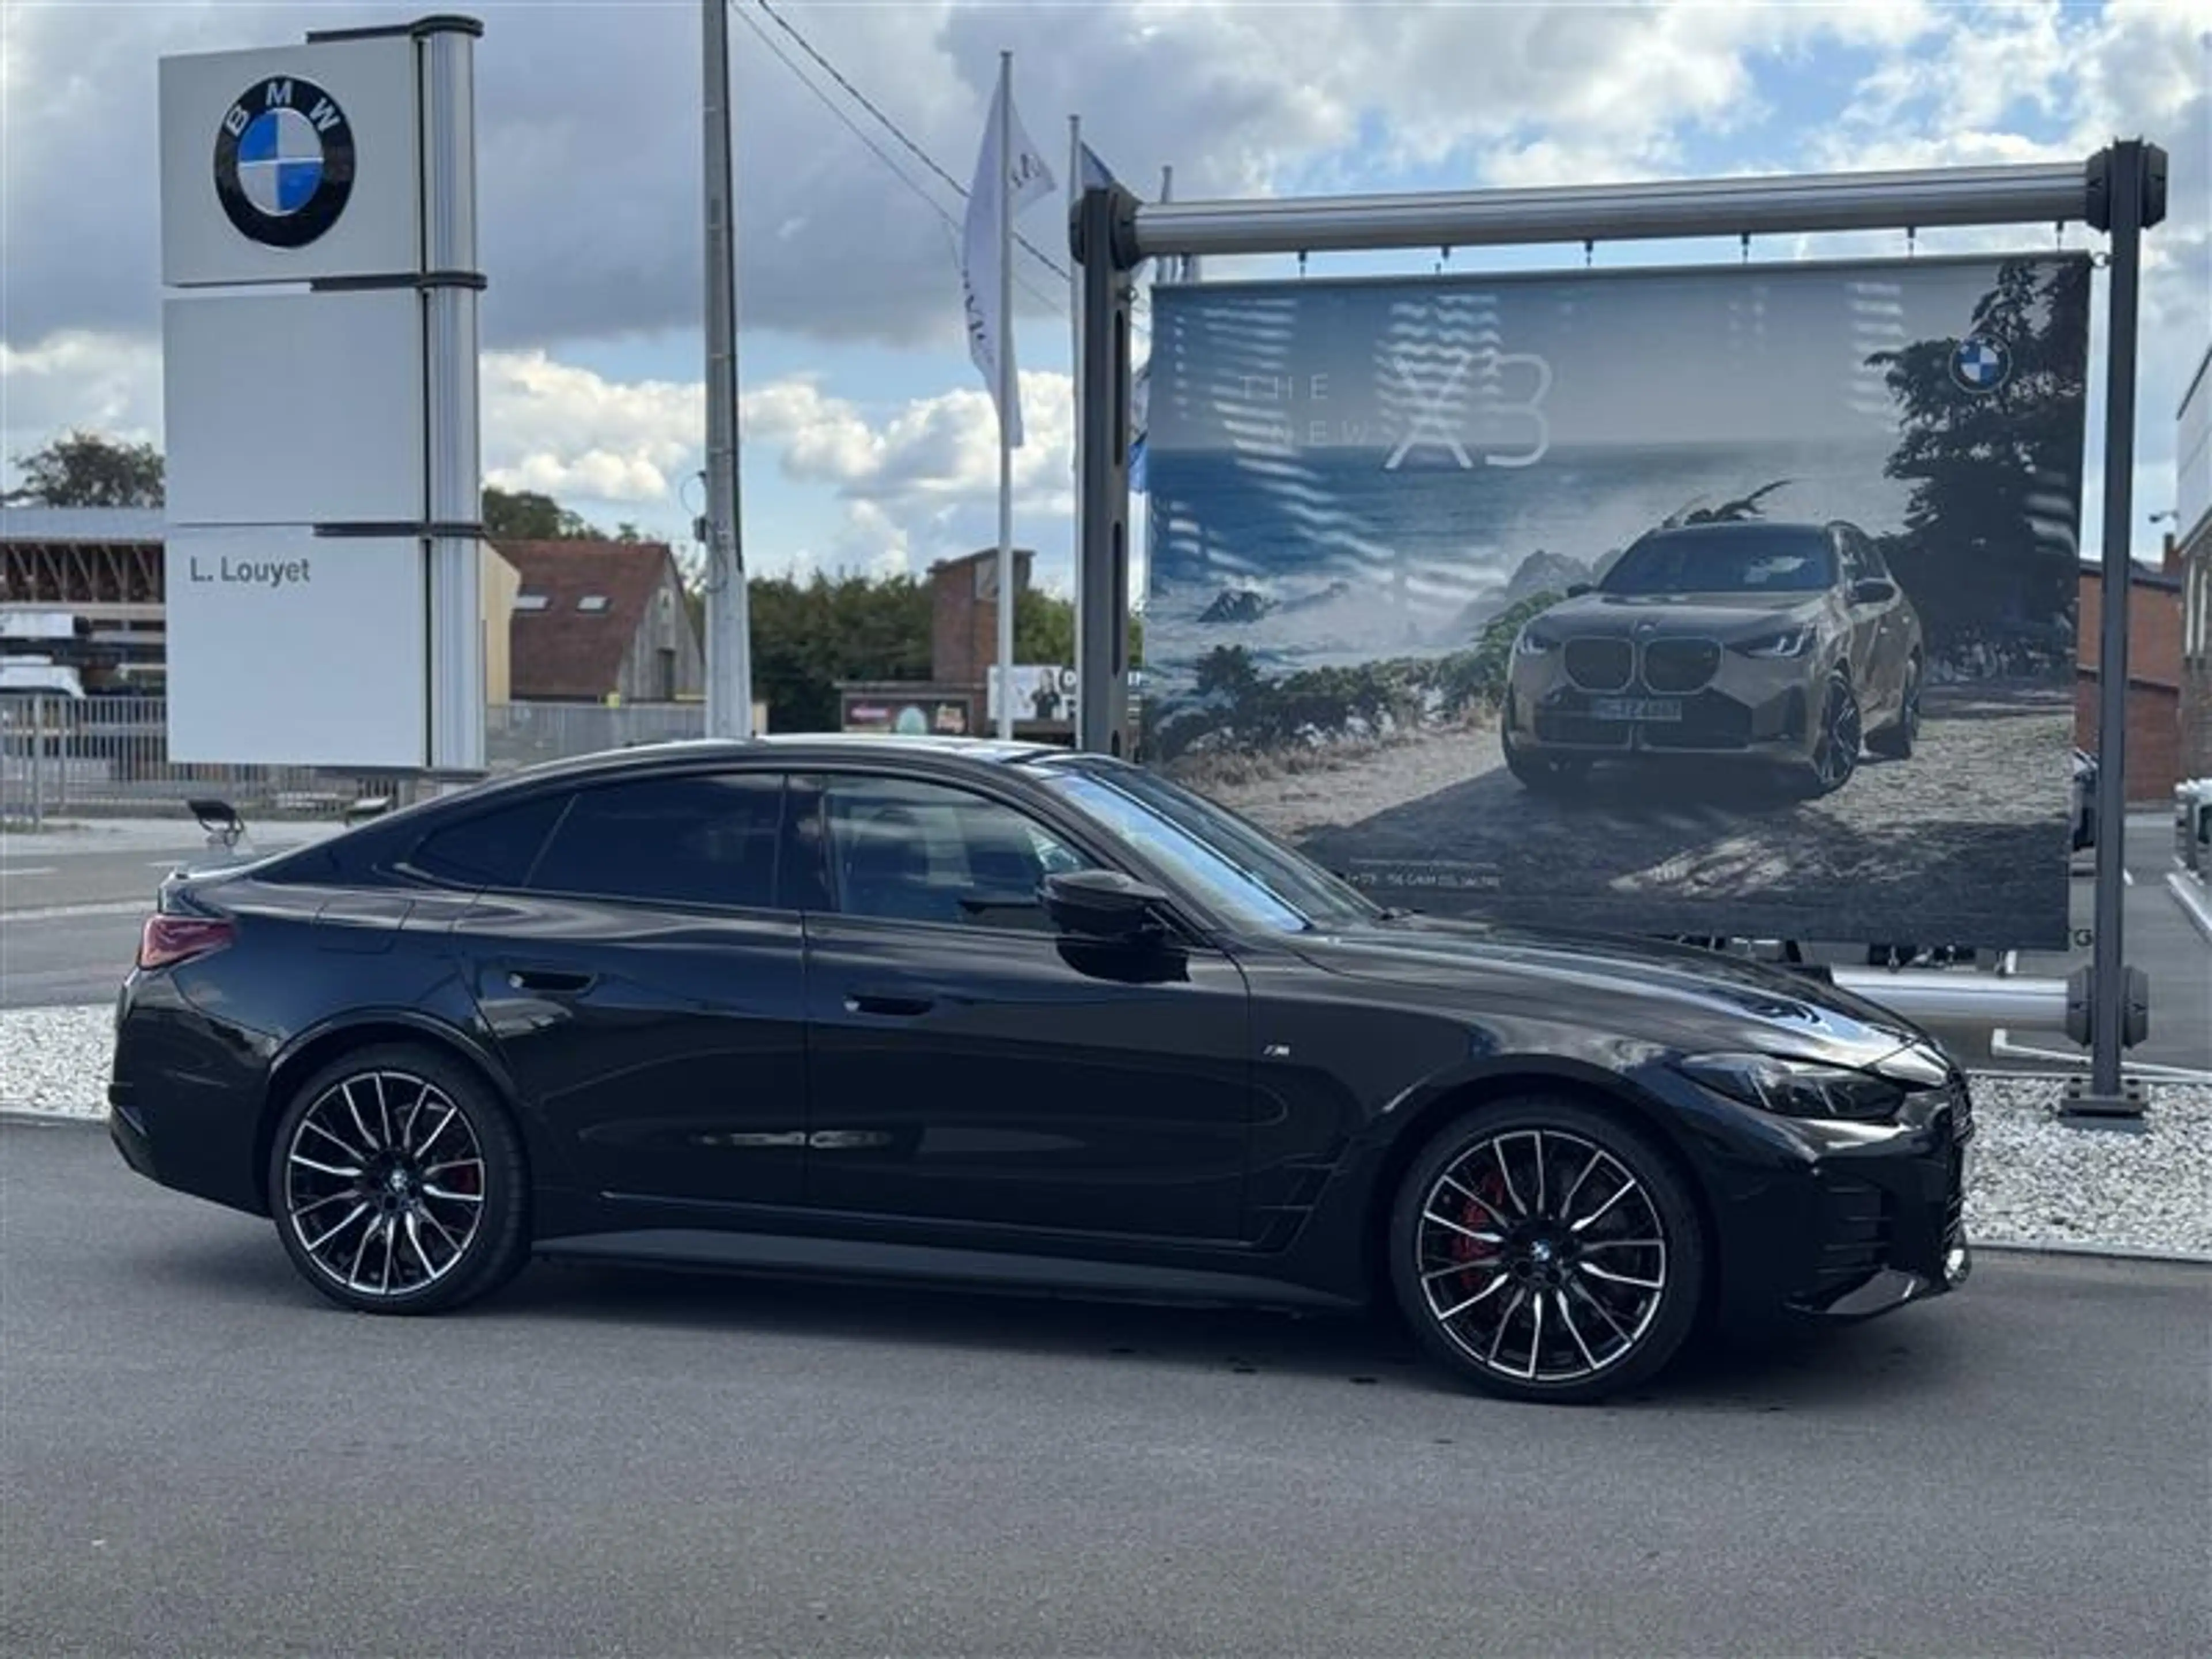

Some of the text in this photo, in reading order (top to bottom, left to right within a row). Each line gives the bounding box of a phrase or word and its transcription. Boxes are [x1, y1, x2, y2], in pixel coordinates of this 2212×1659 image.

[226, 81, 340, 137] BMW
[1238, 373, 1328, 400] THE
[1382, 352, 1552, 469] X3
[190, 555, 311, 588] L. Louyet
